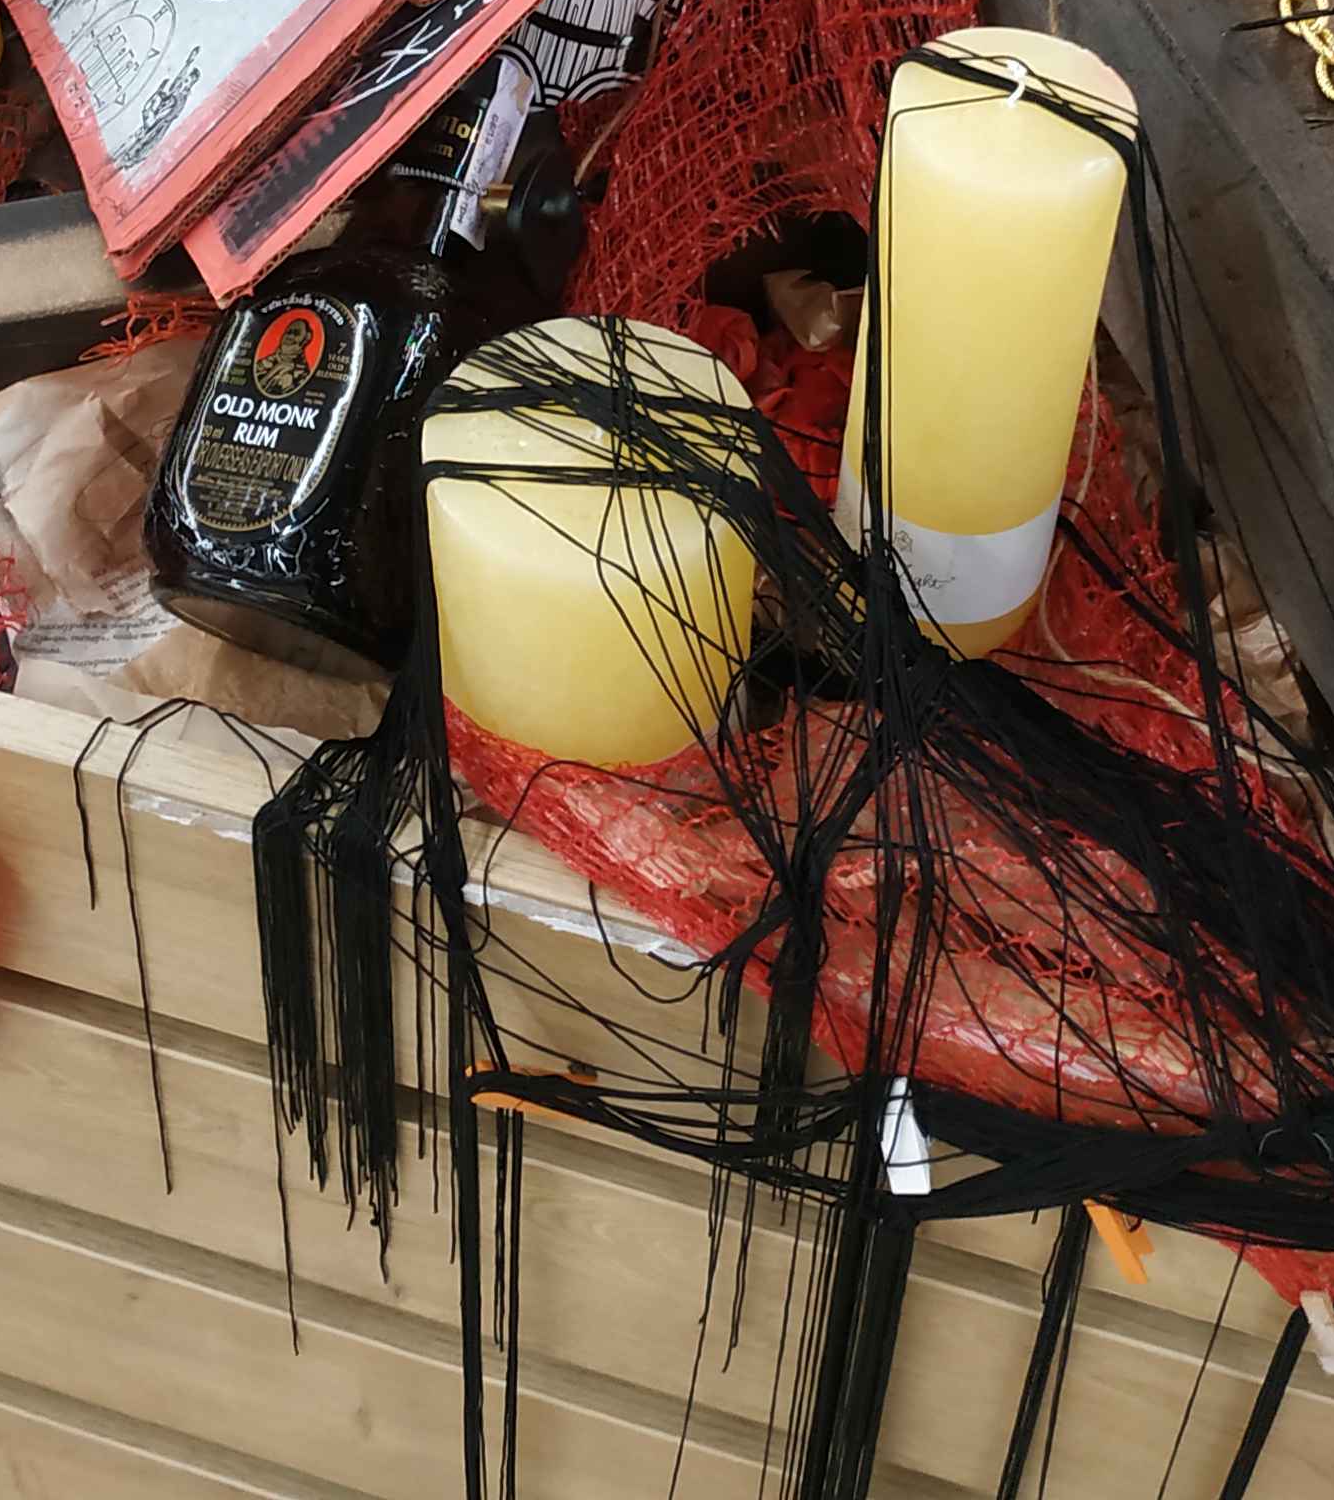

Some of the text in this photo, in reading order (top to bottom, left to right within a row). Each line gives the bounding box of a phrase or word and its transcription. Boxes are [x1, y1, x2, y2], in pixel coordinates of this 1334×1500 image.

[336, 341, 348, 355] 7
[327, 353, 351, 365] YEARS
[327, 361, 345, 372] OLD
[213, 392, 320, 430] OLD MONK
[232, 421, 280, 449] RUM
[204, 441, 256, 475] OVERSEAS
